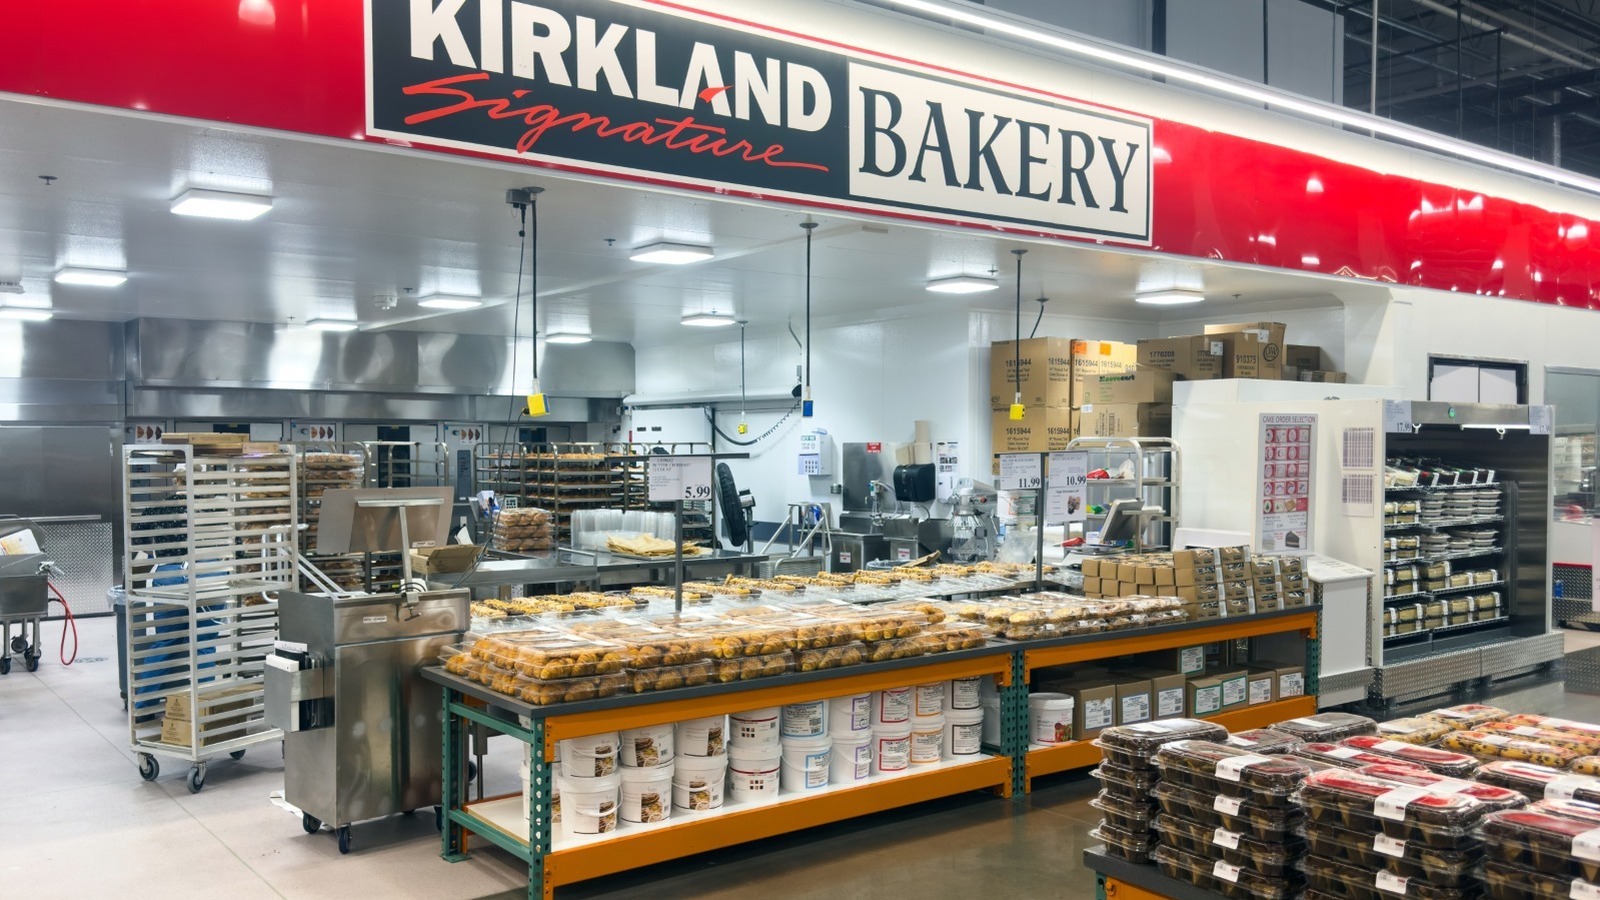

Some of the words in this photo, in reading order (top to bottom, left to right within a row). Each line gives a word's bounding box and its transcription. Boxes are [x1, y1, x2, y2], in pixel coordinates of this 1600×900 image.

[410, 0, 832, 132] KIRKLAND
[402, 73, 829, 172] Signature
[858, 86, 1140, 214] BAKERY
[1005, 358, 1032, 367] 161944
[1006, 427, 1031, 435] 1615944
[1018, 477, 1041, 488] 11.99
[1066, 475, 1087, 486] 10.99
[685, 486, 711, 499] 5.99
